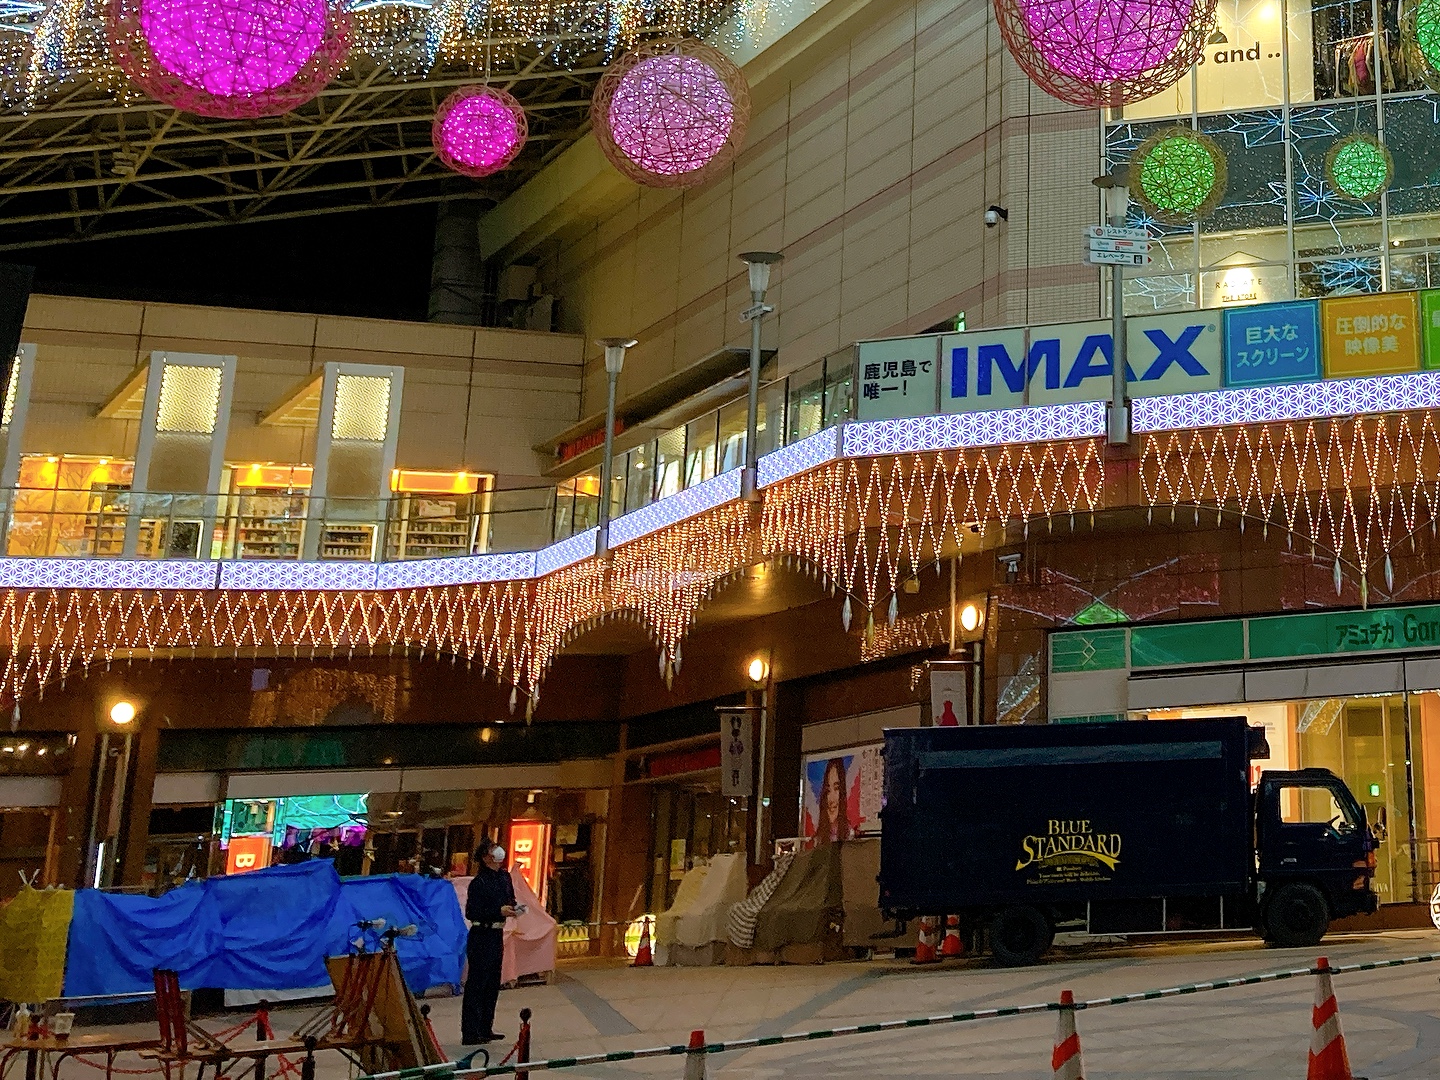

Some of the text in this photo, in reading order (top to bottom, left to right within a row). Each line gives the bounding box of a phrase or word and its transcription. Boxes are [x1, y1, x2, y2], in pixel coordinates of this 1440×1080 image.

[1214, 41, 1260, 64] and
[1246, 324, 1299, 345] 巨大な
[1335, 313, 1407, 335] 圧倒的な
[1345, 335, 1399, 355] 映像美
[1236, 346, 1310, 368] スクリーン
[863, 360, 932, 380] 鹿児島で
[863, 379, 908, 400] 唯一!
[1335, 621, 1394, 647] アミュチカ
[1048, 820, 1093, 834] BLUE
[1017, 833, 1122, 868] STANDARD
